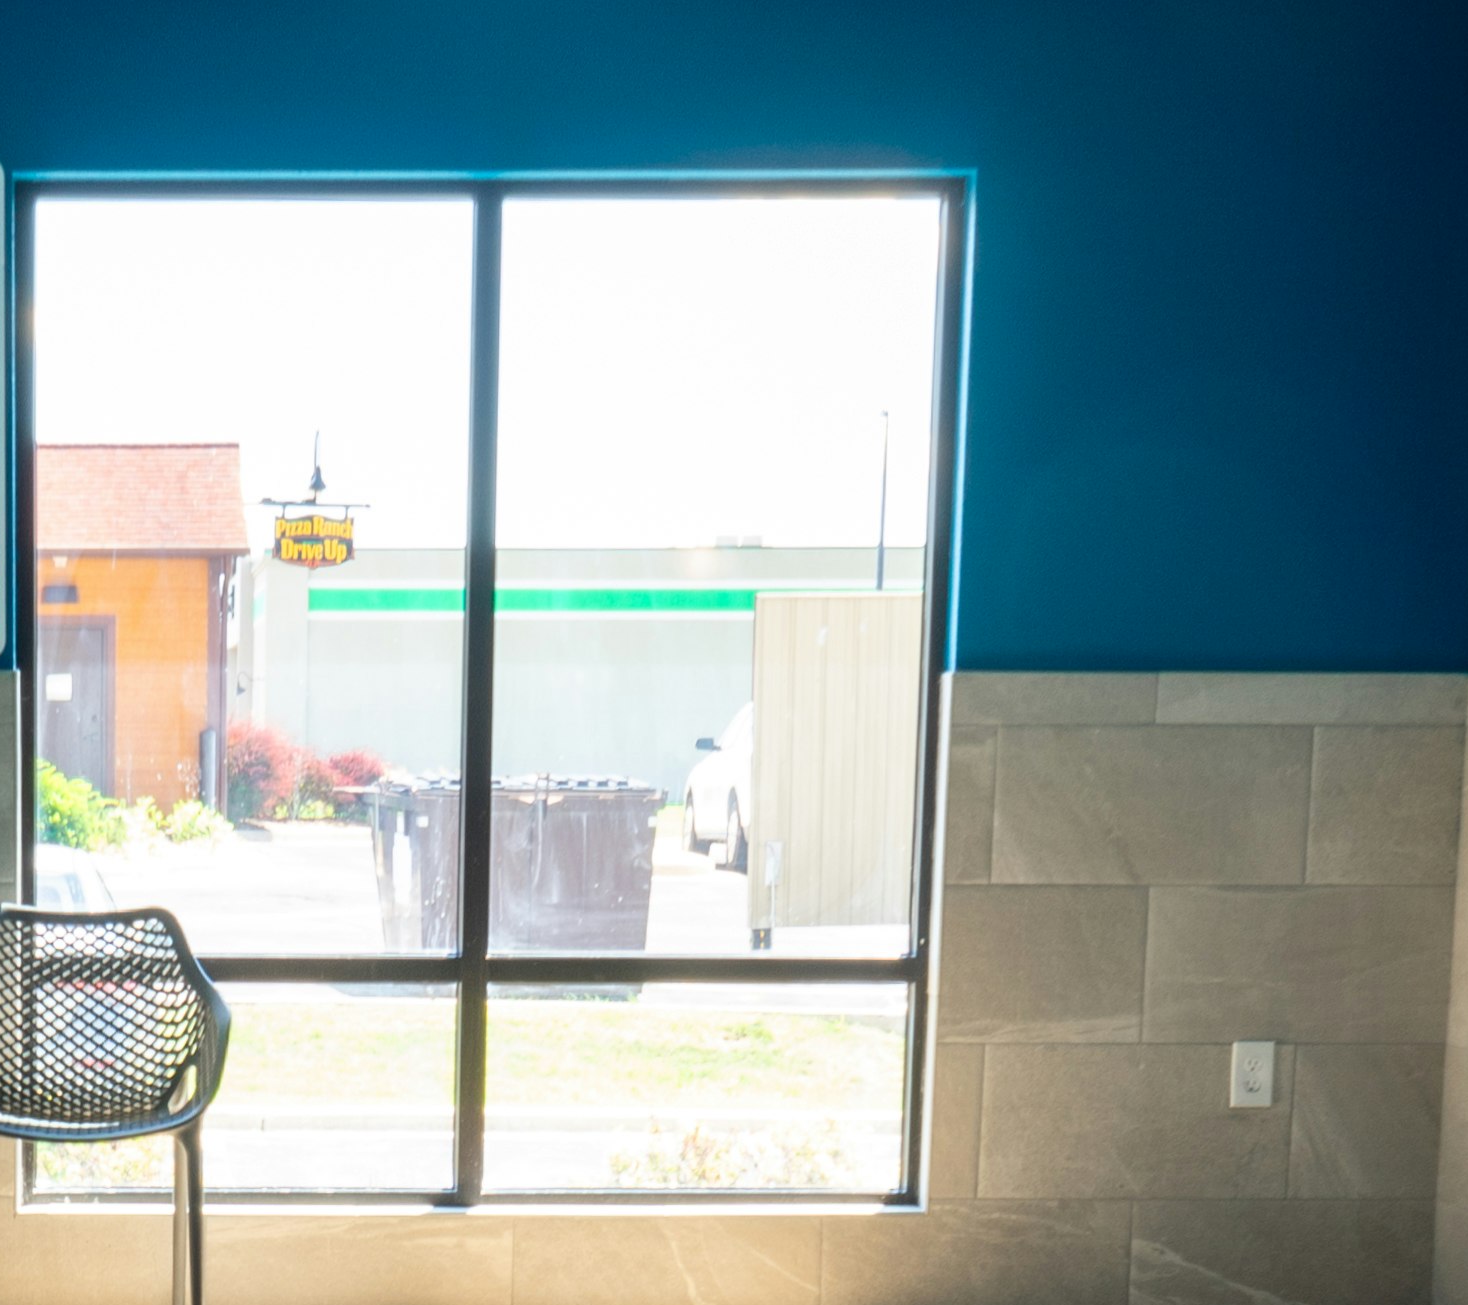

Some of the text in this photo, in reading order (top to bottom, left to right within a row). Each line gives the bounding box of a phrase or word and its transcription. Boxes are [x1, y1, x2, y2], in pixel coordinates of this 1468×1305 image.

[276, 515, 352, 539] Pizza Ranch
[280, 538, 347, 564] Drive Up
